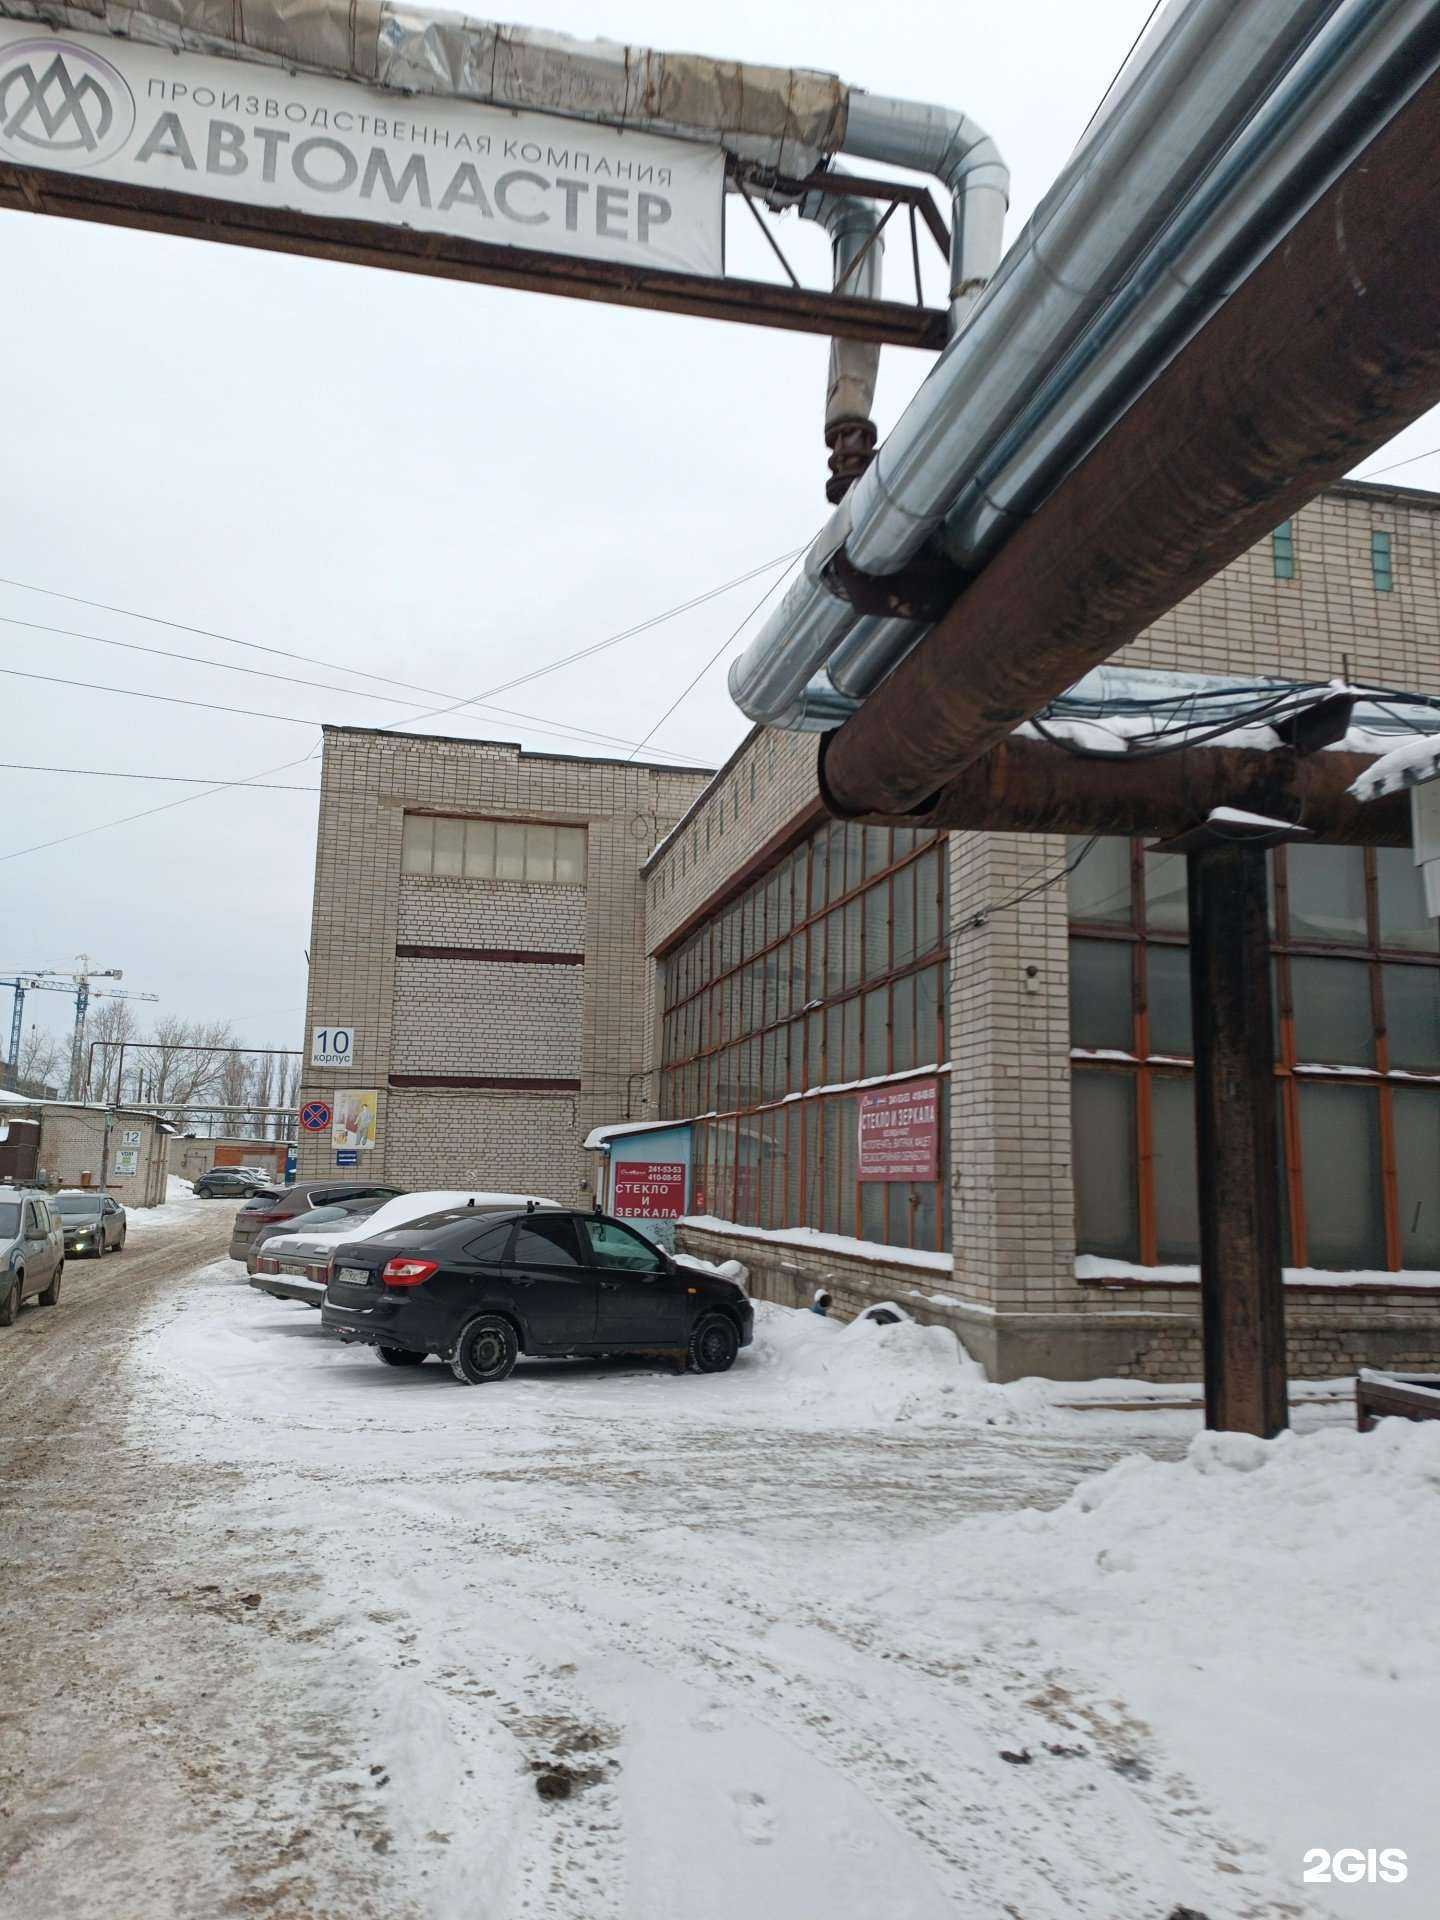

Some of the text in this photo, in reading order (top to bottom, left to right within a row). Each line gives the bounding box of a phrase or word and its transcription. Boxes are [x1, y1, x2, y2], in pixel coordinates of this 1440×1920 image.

[147, 78, 672, 187] ПРОИЗВОДСТВЕННАЯ КОМПАНИЯ
[134, 111, 673, 243] АВТОМАСТЕР
[317, 1030, 349, 1054] 10
[313, 1054, 351, 1064] корпус
[126, 1132, 139, 1142] 12
[616, 1184, 669, 1194] СТЕКЛО
[641, 1196, 650, 1206] И
[616, 1207, 678, 1218] ЗЕРКАЛА
